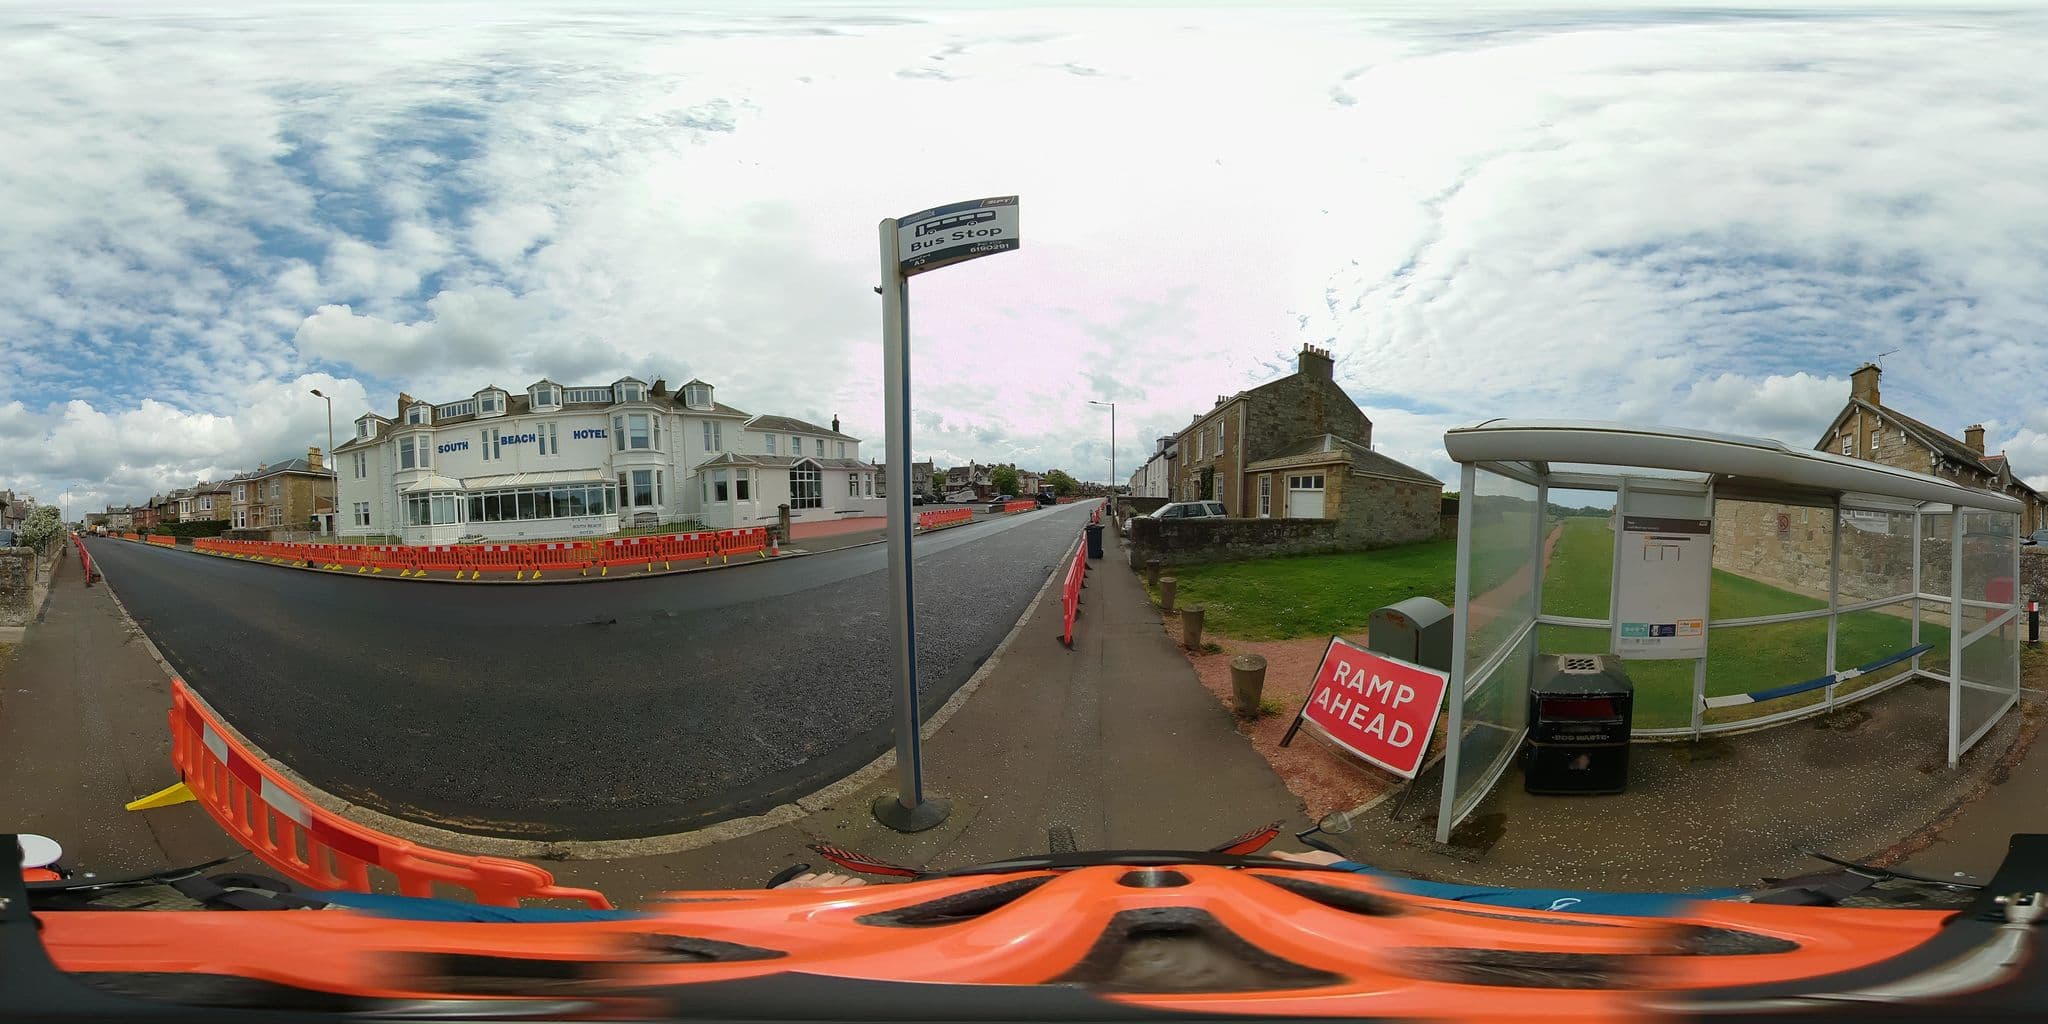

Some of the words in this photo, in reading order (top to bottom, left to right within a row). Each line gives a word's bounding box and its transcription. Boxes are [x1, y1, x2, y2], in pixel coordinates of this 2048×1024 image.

[911, 237, 945, 252] Bus
[952, 227, 1003, 240] Stop
[438, 441, 469, 454] SOUTH
[501, 433, 536, 445] BEACH
[573, 429, 608, 440] HOTEL
[1333, 660, 1415, 709] RAMP
[1314, 686, 1414, 748] AHEAD
